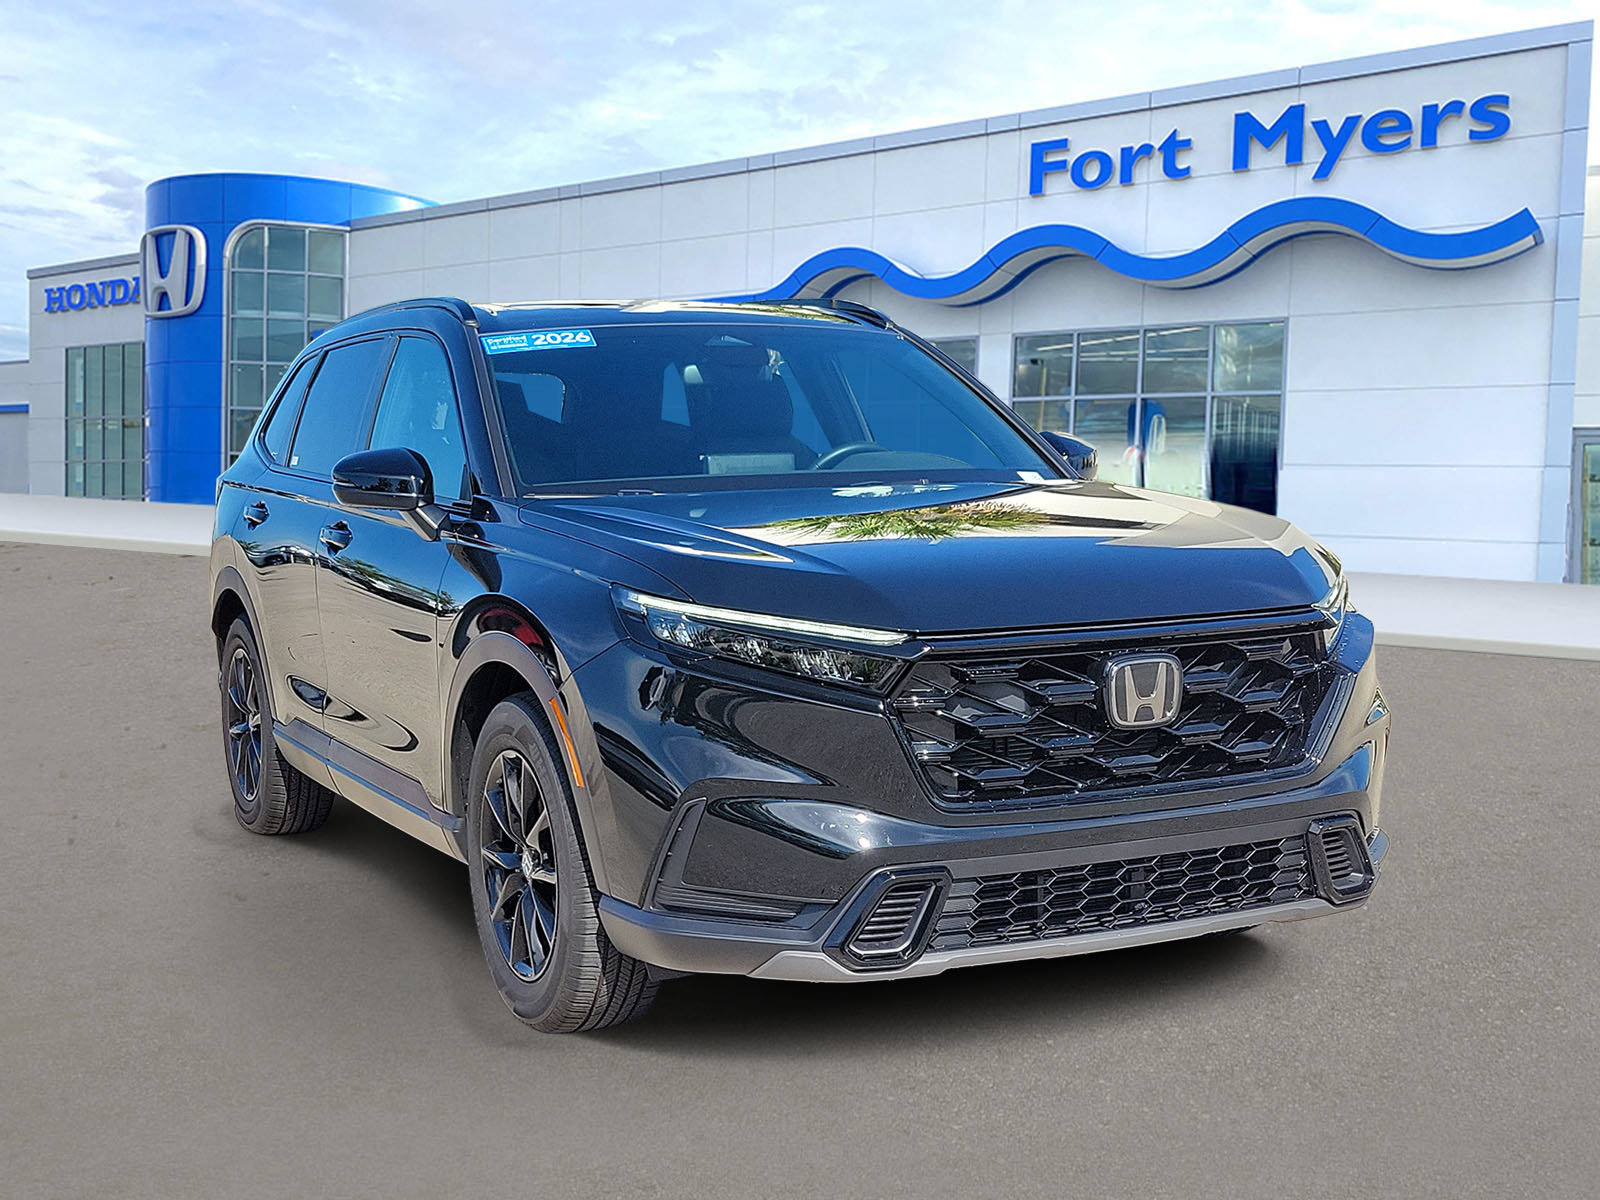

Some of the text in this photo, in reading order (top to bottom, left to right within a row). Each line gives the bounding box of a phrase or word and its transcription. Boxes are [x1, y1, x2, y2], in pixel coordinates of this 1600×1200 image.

[1029, 93, 1512, 196] Fort Myers
[531, 332, 591, 345] 2026
